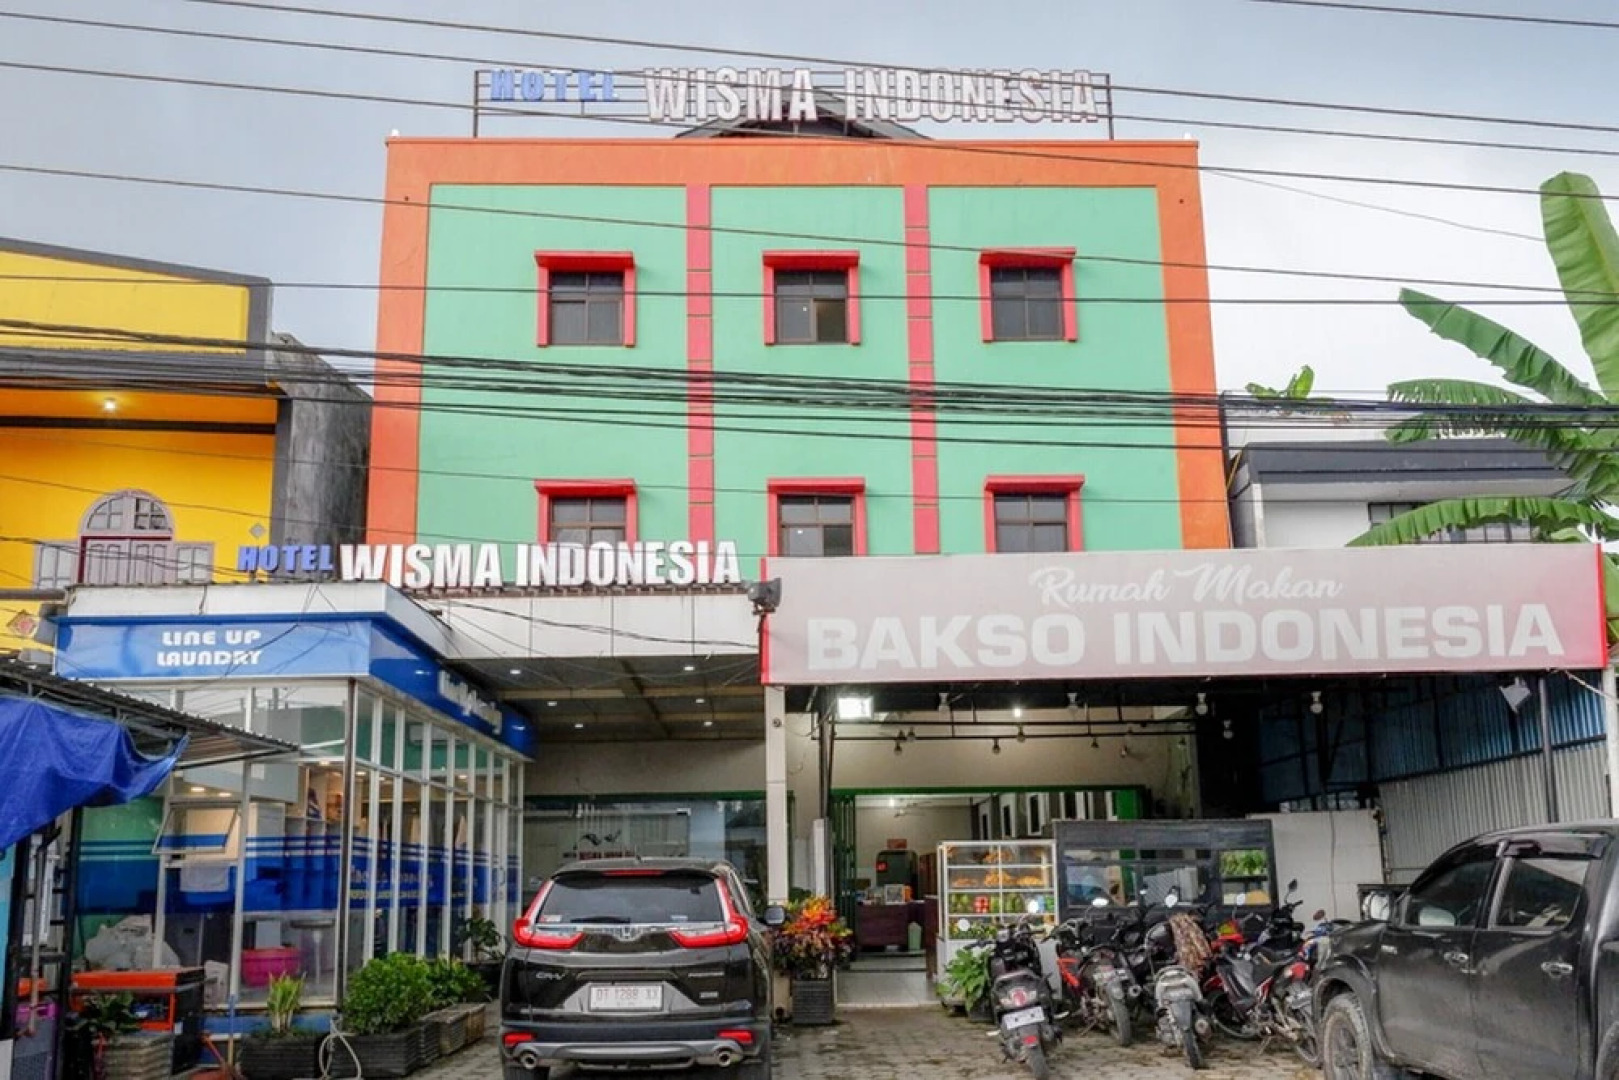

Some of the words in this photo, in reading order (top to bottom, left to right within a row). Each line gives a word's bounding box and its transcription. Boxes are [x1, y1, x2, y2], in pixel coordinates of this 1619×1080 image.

[490, 69, 619, 102] HOTEL
[643, 66, 818, 122] WISMA
[843, 68, 1099, 123] INDONESIA
[236, 544, 334, 572] HOTEL
[339, 543, 502, 588] WISMA
[515, 540, 742, 587] INDONESIA
[1028, 565, 1173, 608] Rumah
[1172, 562, 1343, 605] Makan
[156, 650, 262, 667] LAUNDRY
[225, 629, 261, 645] UP
[806, 611, 1086, 671] BAKSO
[1112, 603, 1565, 666] INDONESIA
